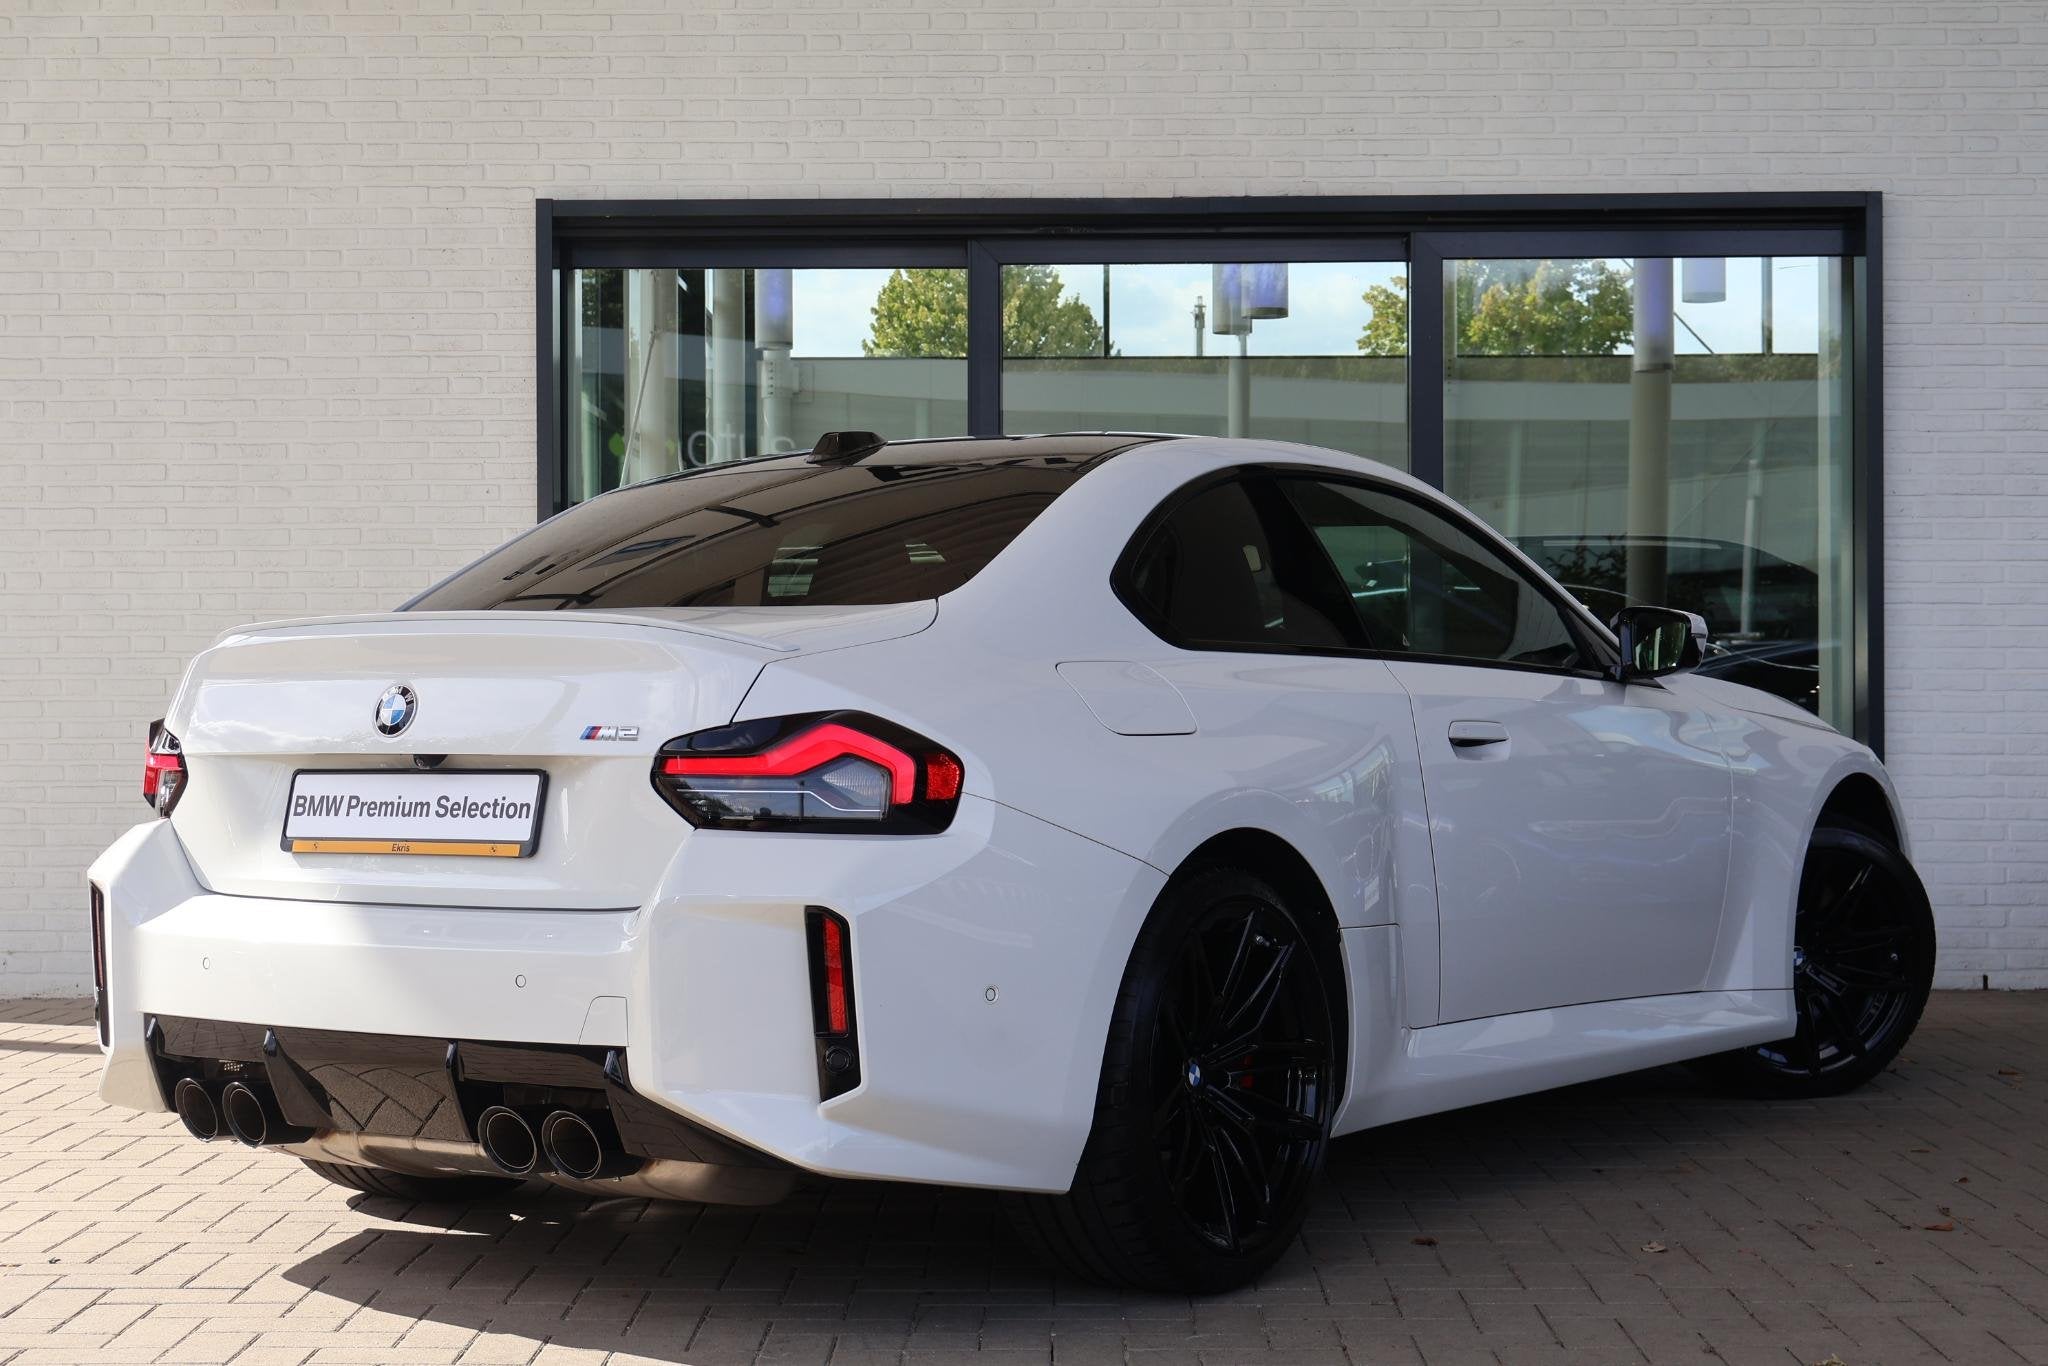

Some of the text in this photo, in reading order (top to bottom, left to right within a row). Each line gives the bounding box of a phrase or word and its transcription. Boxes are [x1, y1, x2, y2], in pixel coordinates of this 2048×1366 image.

[596, 726, 640, 741] M2
[293, 795, 531, 819] BMW Premium Selection
[391, 843, 411, 852] Ekris
